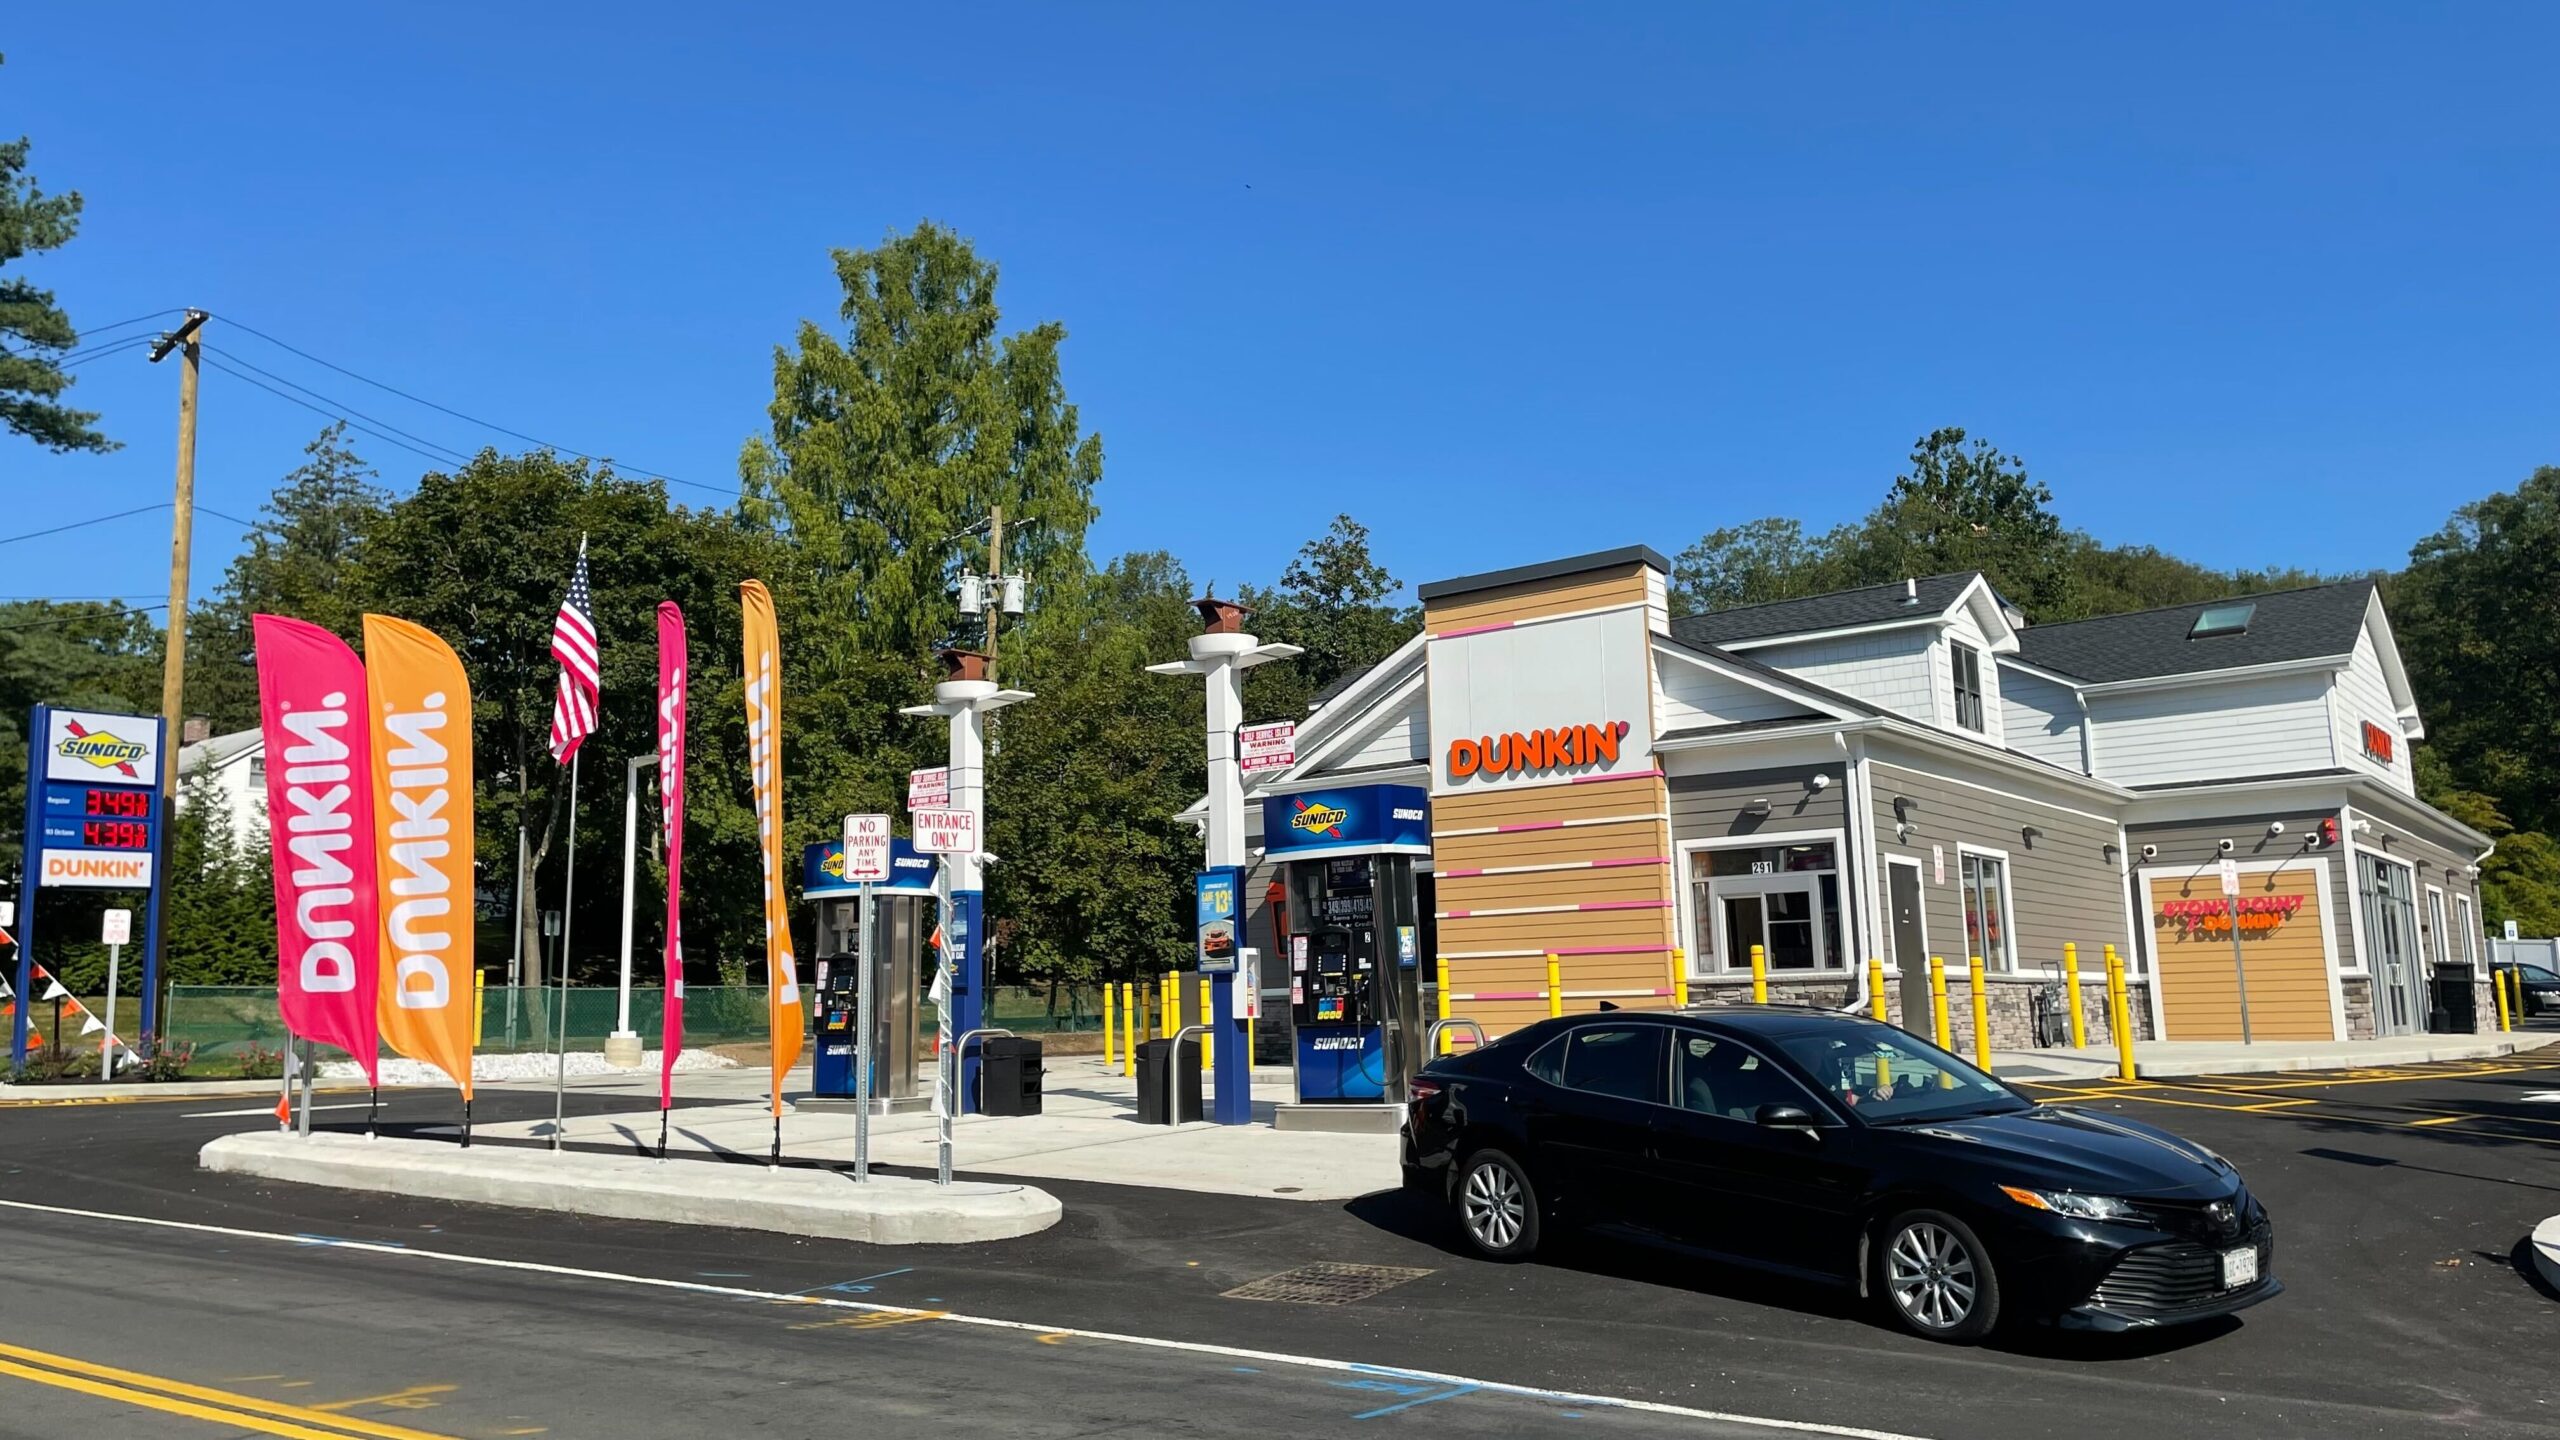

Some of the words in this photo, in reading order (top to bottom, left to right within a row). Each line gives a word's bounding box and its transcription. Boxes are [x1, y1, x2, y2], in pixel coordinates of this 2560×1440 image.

[63, 741, 142, 758] SUNOCO
[1250, 739, 1286, 748] WARNING
[1450, 721, 1628, 777] DUNKIN'
[1293, 811, 1343, 826] SUNOCO
[1392, 808, 1423, 820] SUNOCO
[859, 821, 876, 833] NO
[918, 813, 971, 830] ENTRANCE
[848, 835, 886, 847] PARKING
[931, 832, 958, 848] ONLY
[858, 848, 876, 857] ANY
[48, 858, 144, 878] DUNKIN'
[822, 860, 843, 871] SUNO
[857, 858, 877, 867] TIME
[894, 857, 930, 868] SUNOCO
[1753, 862, 1771, 873] 291
[2163, 899, 2232, 917] STONY
[2237, 895, 2304, 912] POINT
